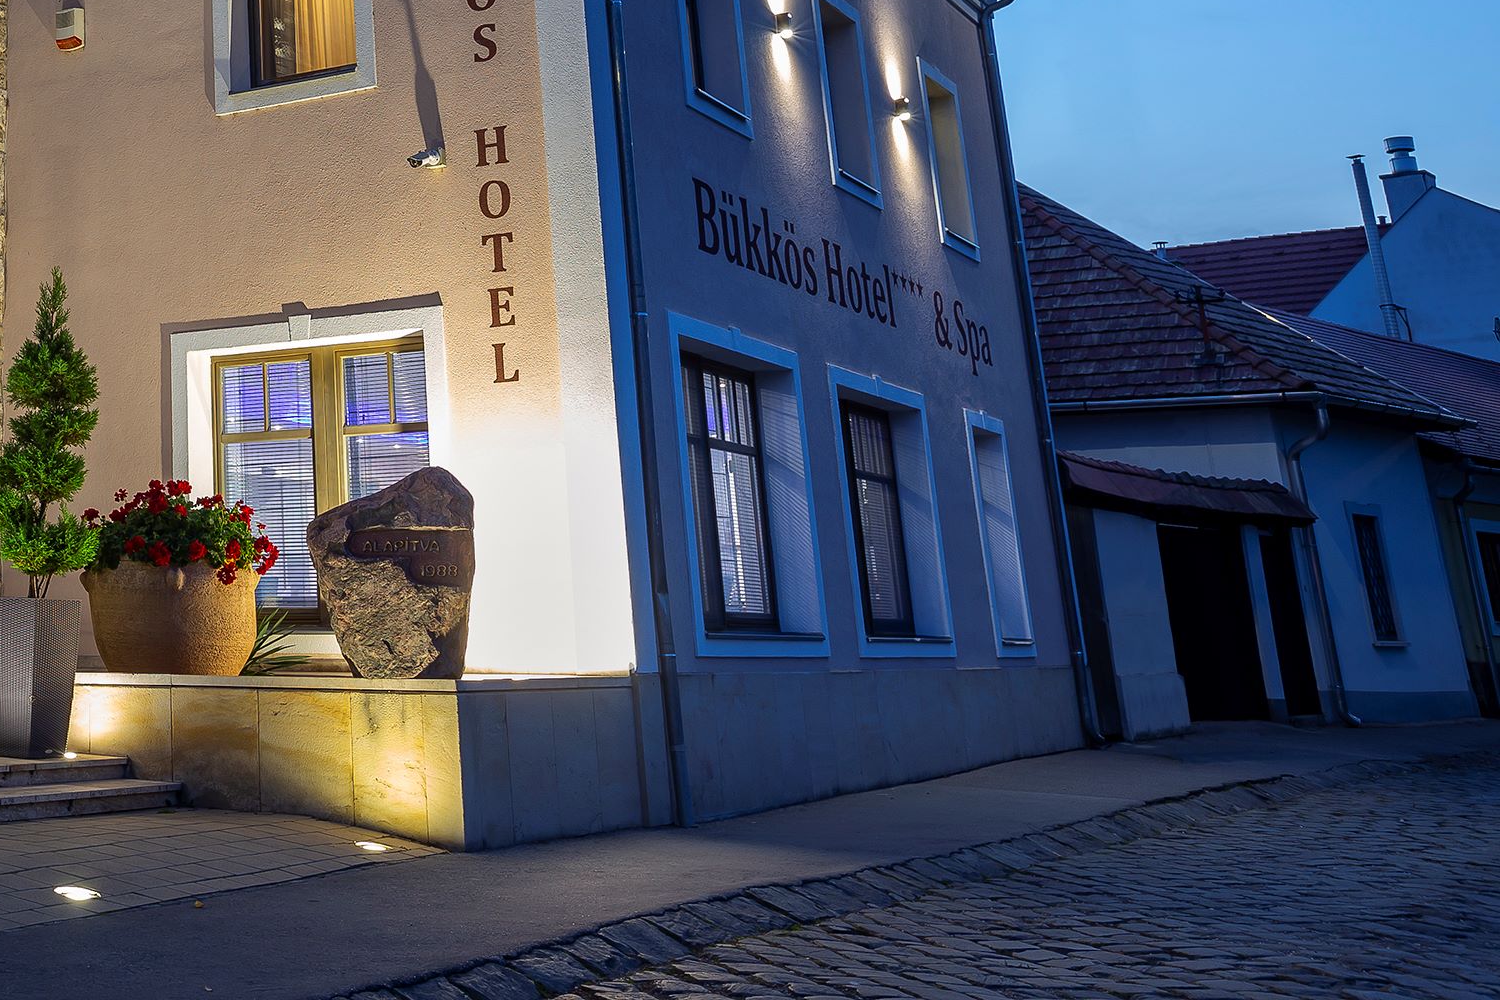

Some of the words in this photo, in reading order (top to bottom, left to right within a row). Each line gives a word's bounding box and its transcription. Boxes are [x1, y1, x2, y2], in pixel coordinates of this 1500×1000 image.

[474, 125, 520, 384] HOTEL
[691, 176, 818, 296] Bükkös
[821, 237, 898, 329] Hotel
[933, 290, 952, 351] &
[953, 299, 994, 377] Spa
[420, 564, 459, 577] 1988
